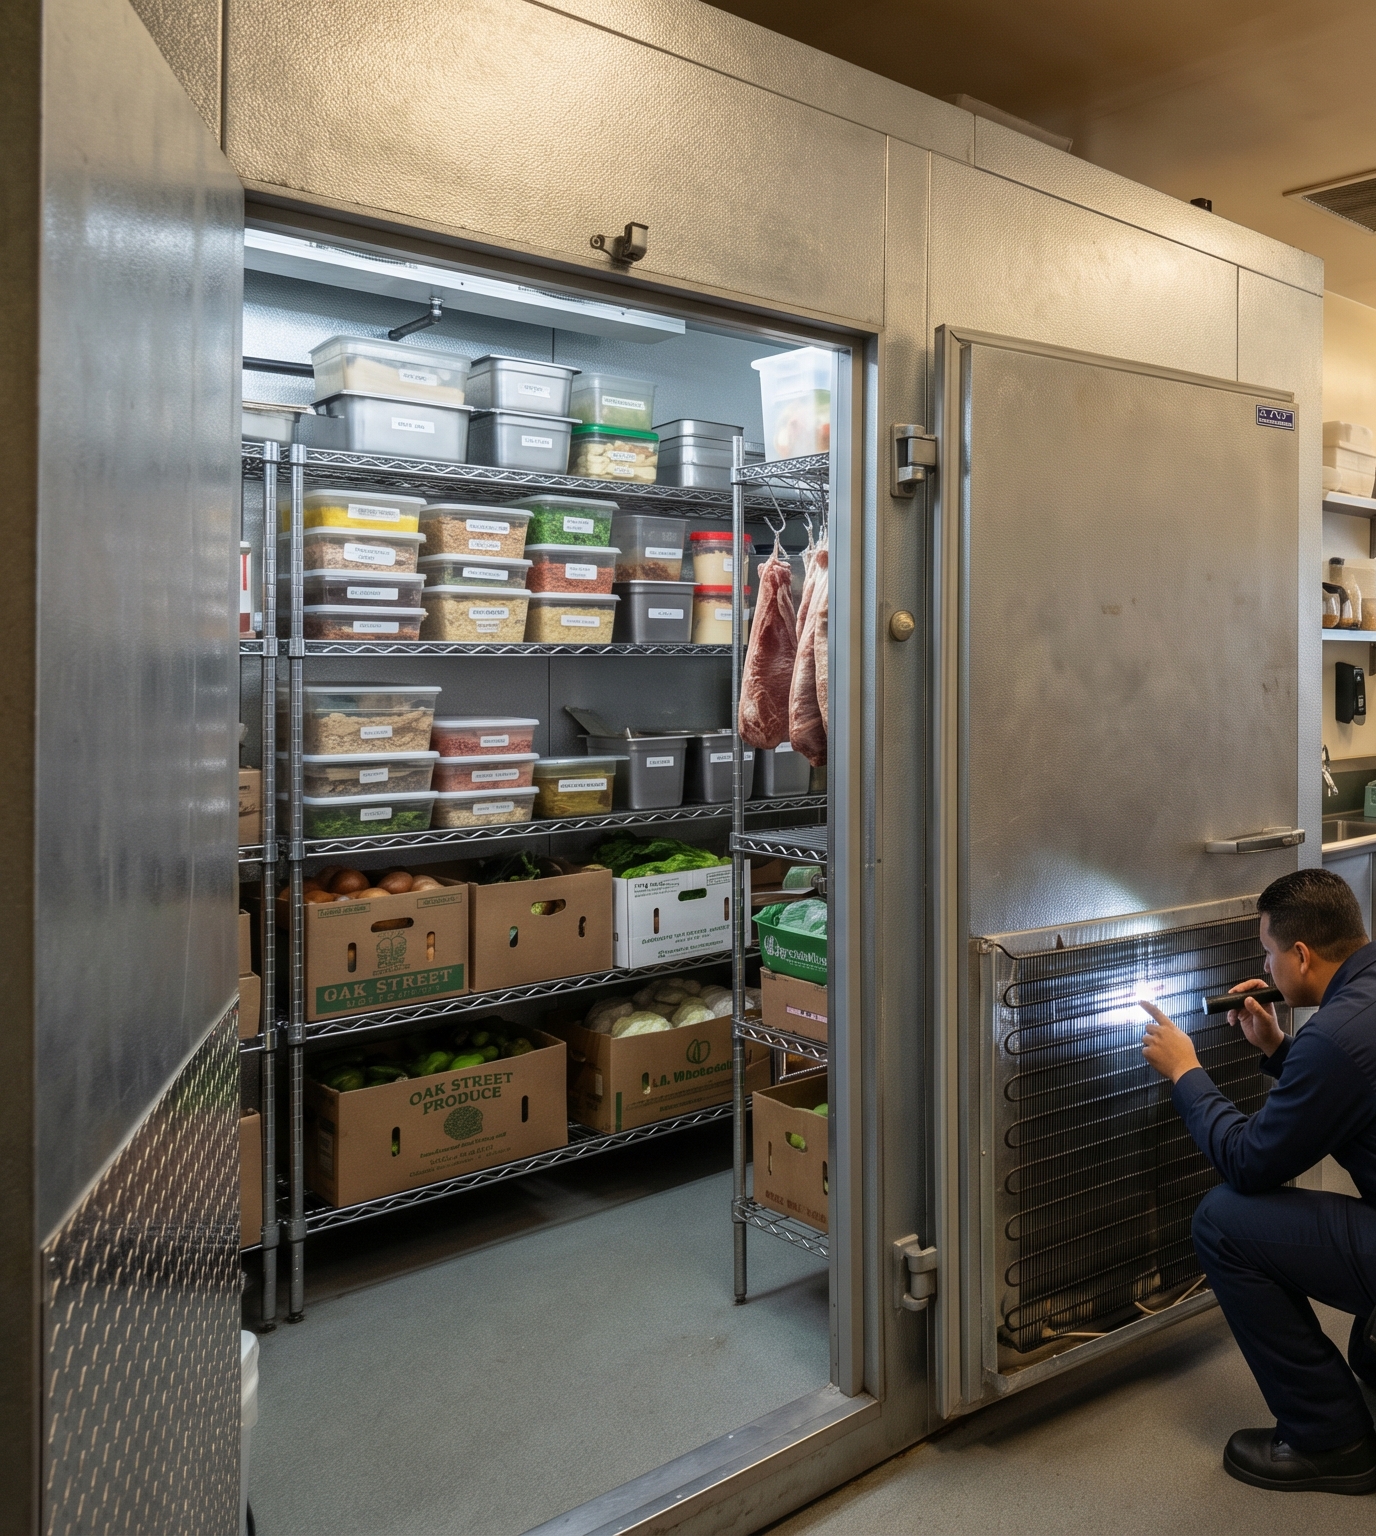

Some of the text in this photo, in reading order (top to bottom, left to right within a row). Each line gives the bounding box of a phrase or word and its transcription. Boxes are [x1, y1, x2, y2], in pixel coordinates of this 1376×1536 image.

[324, 983, 367, 1002] OAK
[376, 969, 452, 993] STREET
[409, 1072, 513, 1106] OAK STREET
[423, 1086, 502, 1115] PRODUCE
